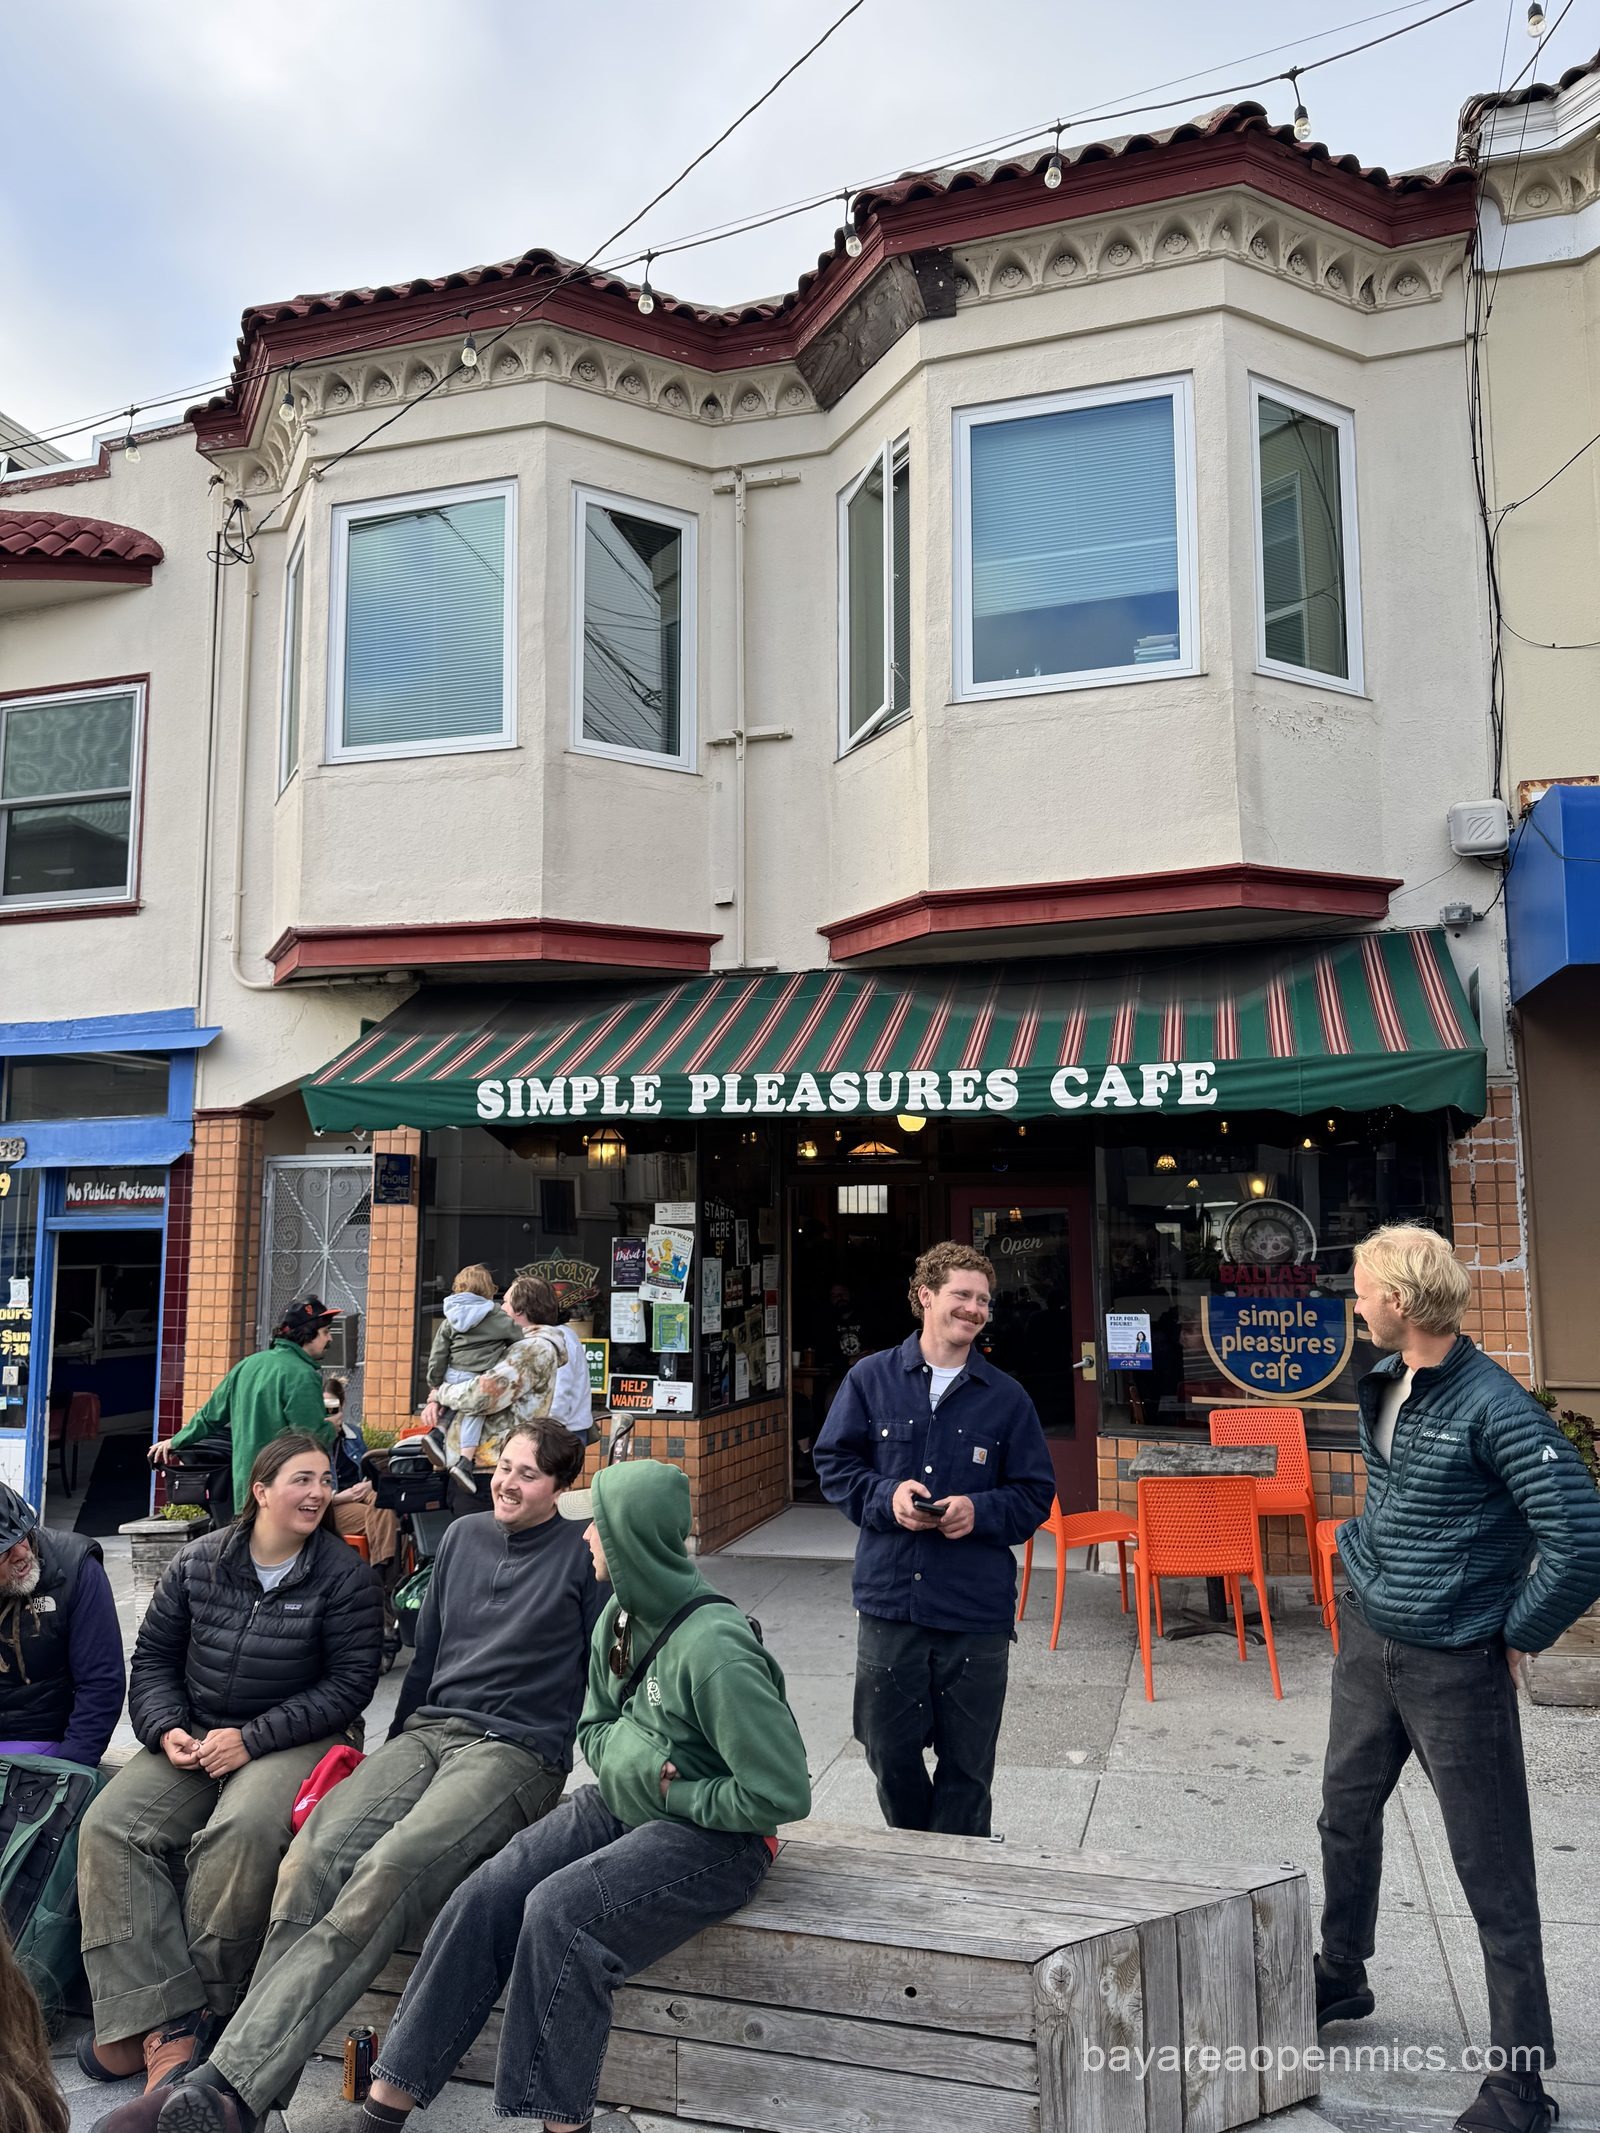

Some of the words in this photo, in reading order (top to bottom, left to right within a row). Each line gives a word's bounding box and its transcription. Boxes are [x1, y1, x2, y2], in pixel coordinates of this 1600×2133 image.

[476, 1074, 663, 1120] SIMPLE
[687, 1068, 1020, 1115] PLEASURES
[1049, 1061, 1219, 1109] CAFE
[381, 1174, 409, 1185] PHONE
[67, 1182, 82, 1201] No
[83, 1181, 117, 1201] Public
[118, 1181, 166, 1200] Restroom
[704, 1201, 735, 1219] STARTS
[1001, 1236, 1043, 1255] Open
[555, 1262, 594, 1285] COAST
[1219, 1264, 1320, 1284] BALLAST
[1238, 1301, 1318, 1335] simple
[1221, 1326, 1337, 1360] pleasures
[1250, 1353, 1303, 1387] cafe
[620, 1379, 648, 1393] HELP
[611, 1394, 654, 1409] WANTED
